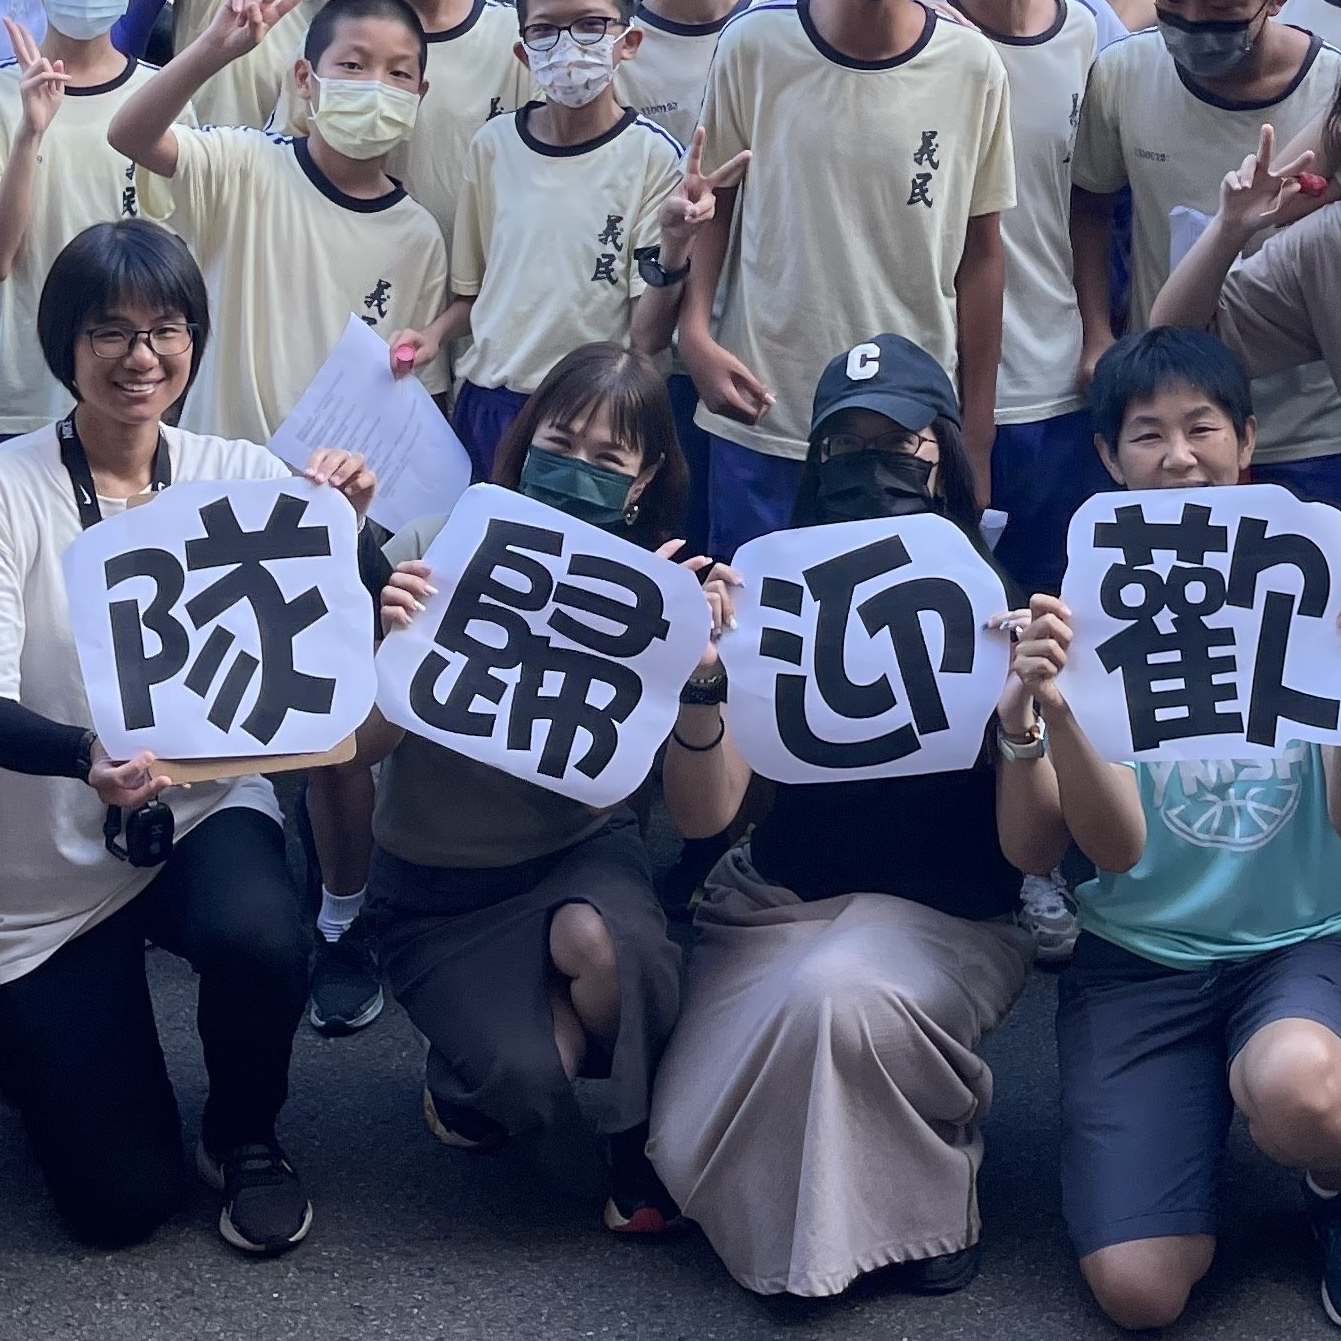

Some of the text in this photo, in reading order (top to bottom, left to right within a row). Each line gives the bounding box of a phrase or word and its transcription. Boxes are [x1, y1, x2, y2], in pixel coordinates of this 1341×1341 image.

[906, 130, 940, 208] 義民
[591, 214, 624, 285] 義民
[846, 342, 881, 381] C
[105, 493, 1340, 779] 歡 迎 歸 隊
